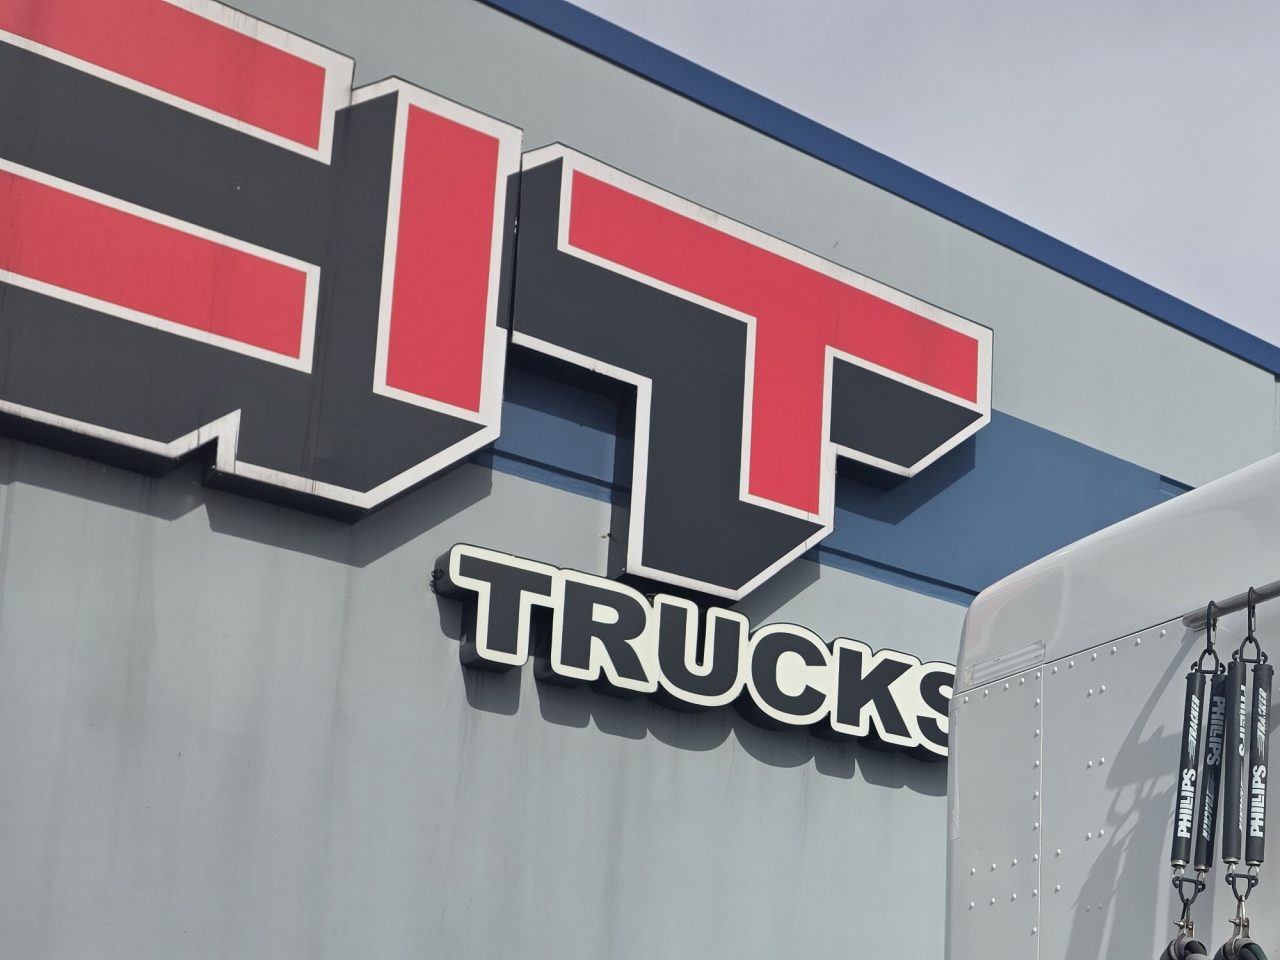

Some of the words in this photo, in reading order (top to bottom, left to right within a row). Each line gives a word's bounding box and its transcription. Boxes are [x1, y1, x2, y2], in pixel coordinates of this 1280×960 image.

[454, 548, 956, 750] TRUCKS
[1206, 696, 1225, 767] PHILLIPS
[1177, 767, 1196, 839] PHILLIPS
[1250, 764, 1267, 838] PHILLIPS
